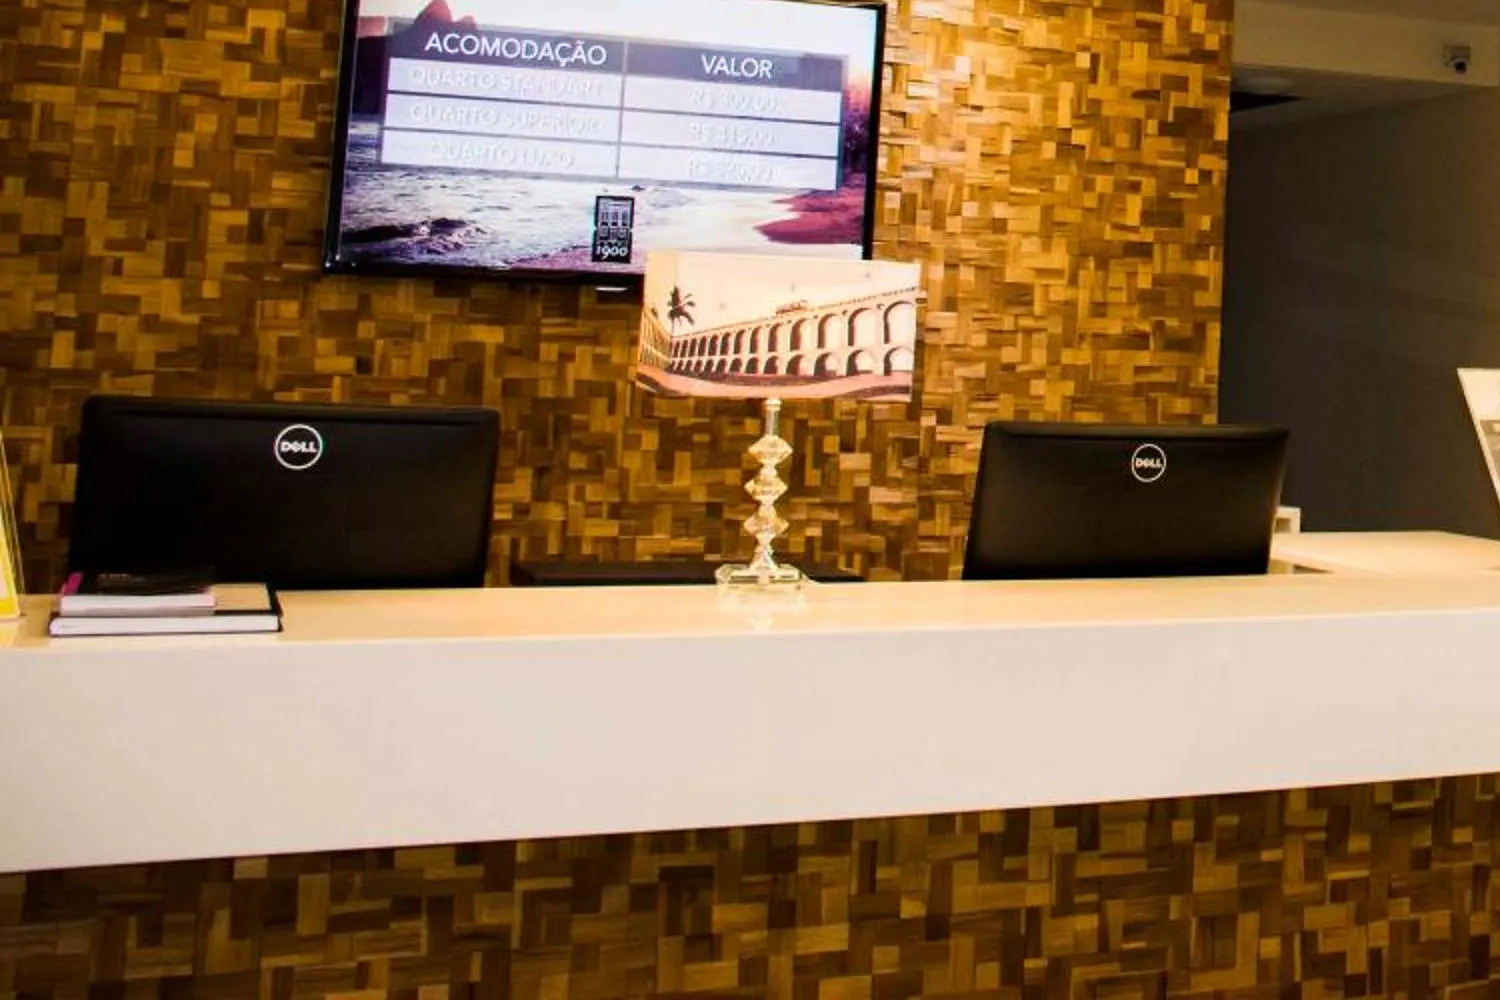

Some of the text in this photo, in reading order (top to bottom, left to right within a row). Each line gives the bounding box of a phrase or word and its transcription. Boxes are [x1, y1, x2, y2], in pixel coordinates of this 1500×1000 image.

[424, 31, 608, 67] ACOMODAÇÃO
[701, 53, 773, 79] VALOR
[280, 440, 317, 453] DELL
[1135, 457, 1163, 468] DELL
